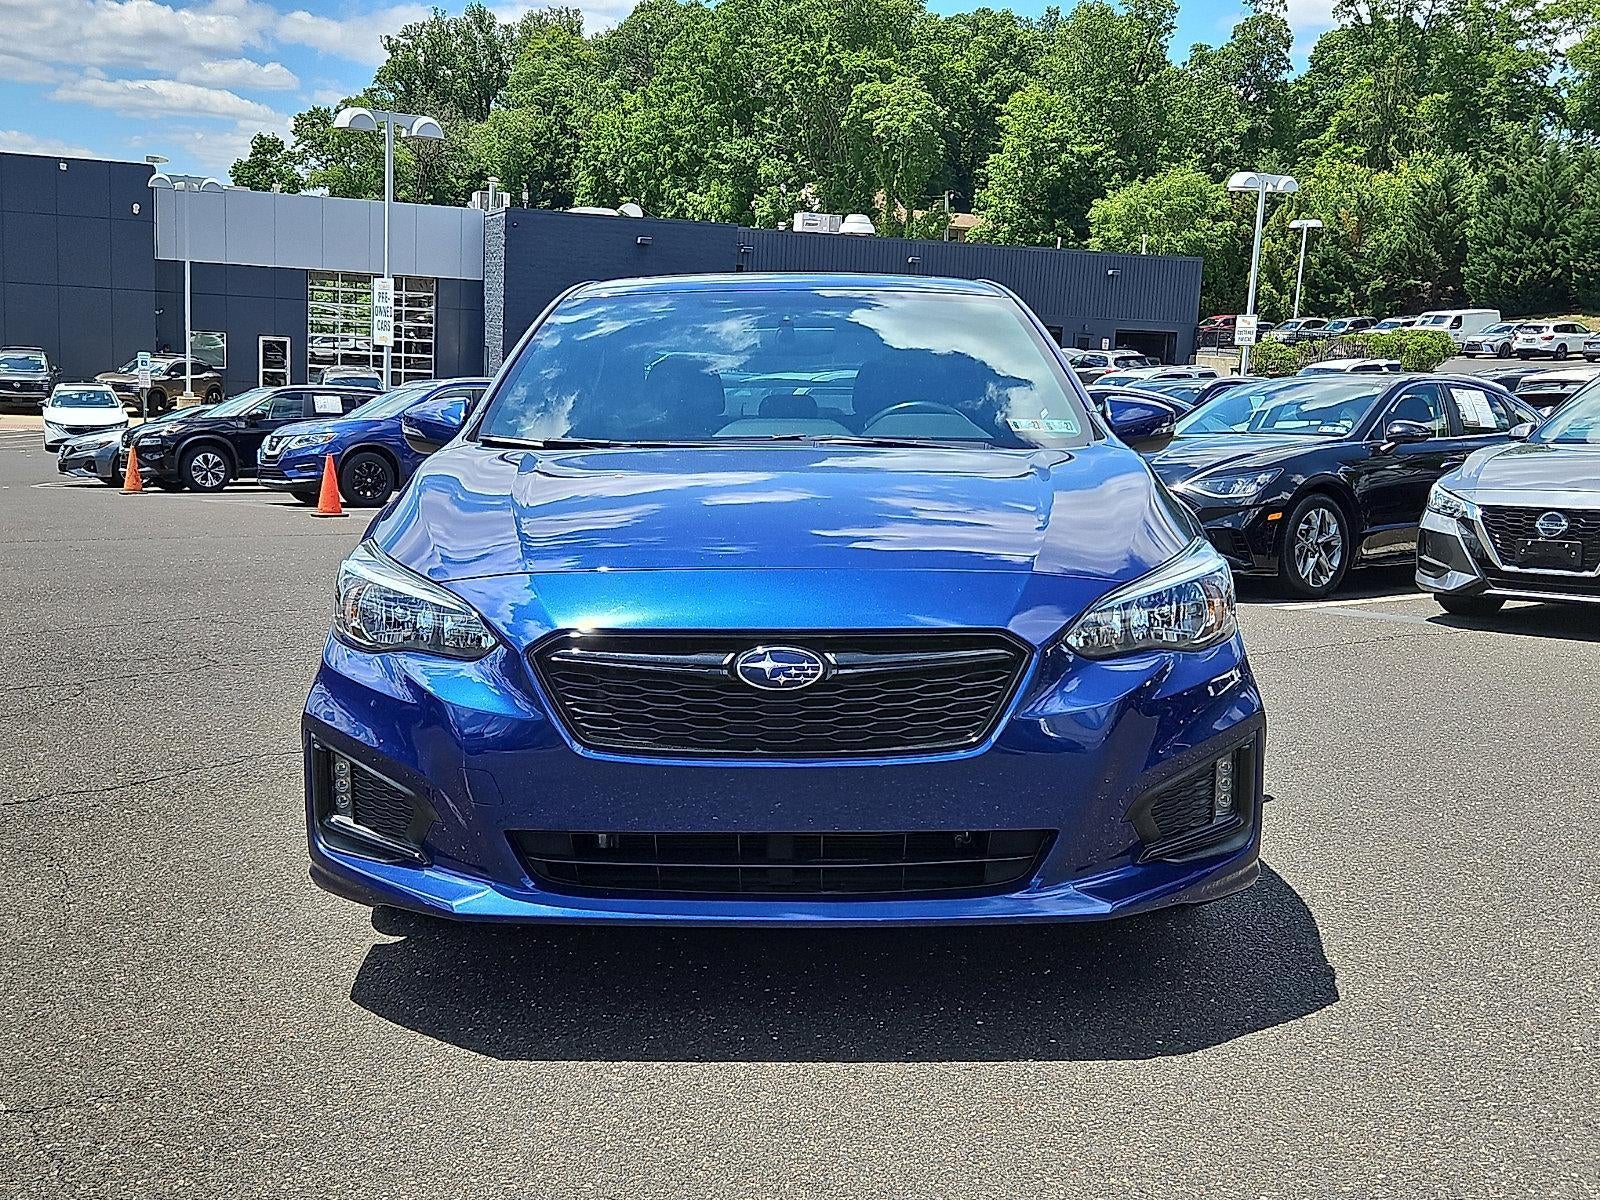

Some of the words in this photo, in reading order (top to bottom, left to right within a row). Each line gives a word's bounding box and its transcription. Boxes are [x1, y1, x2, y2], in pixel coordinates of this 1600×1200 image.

[377, 291, 391, 304] PRE-
[374, 305, 393, 318] OWNED
[376, 319, 391, 332] CARS
